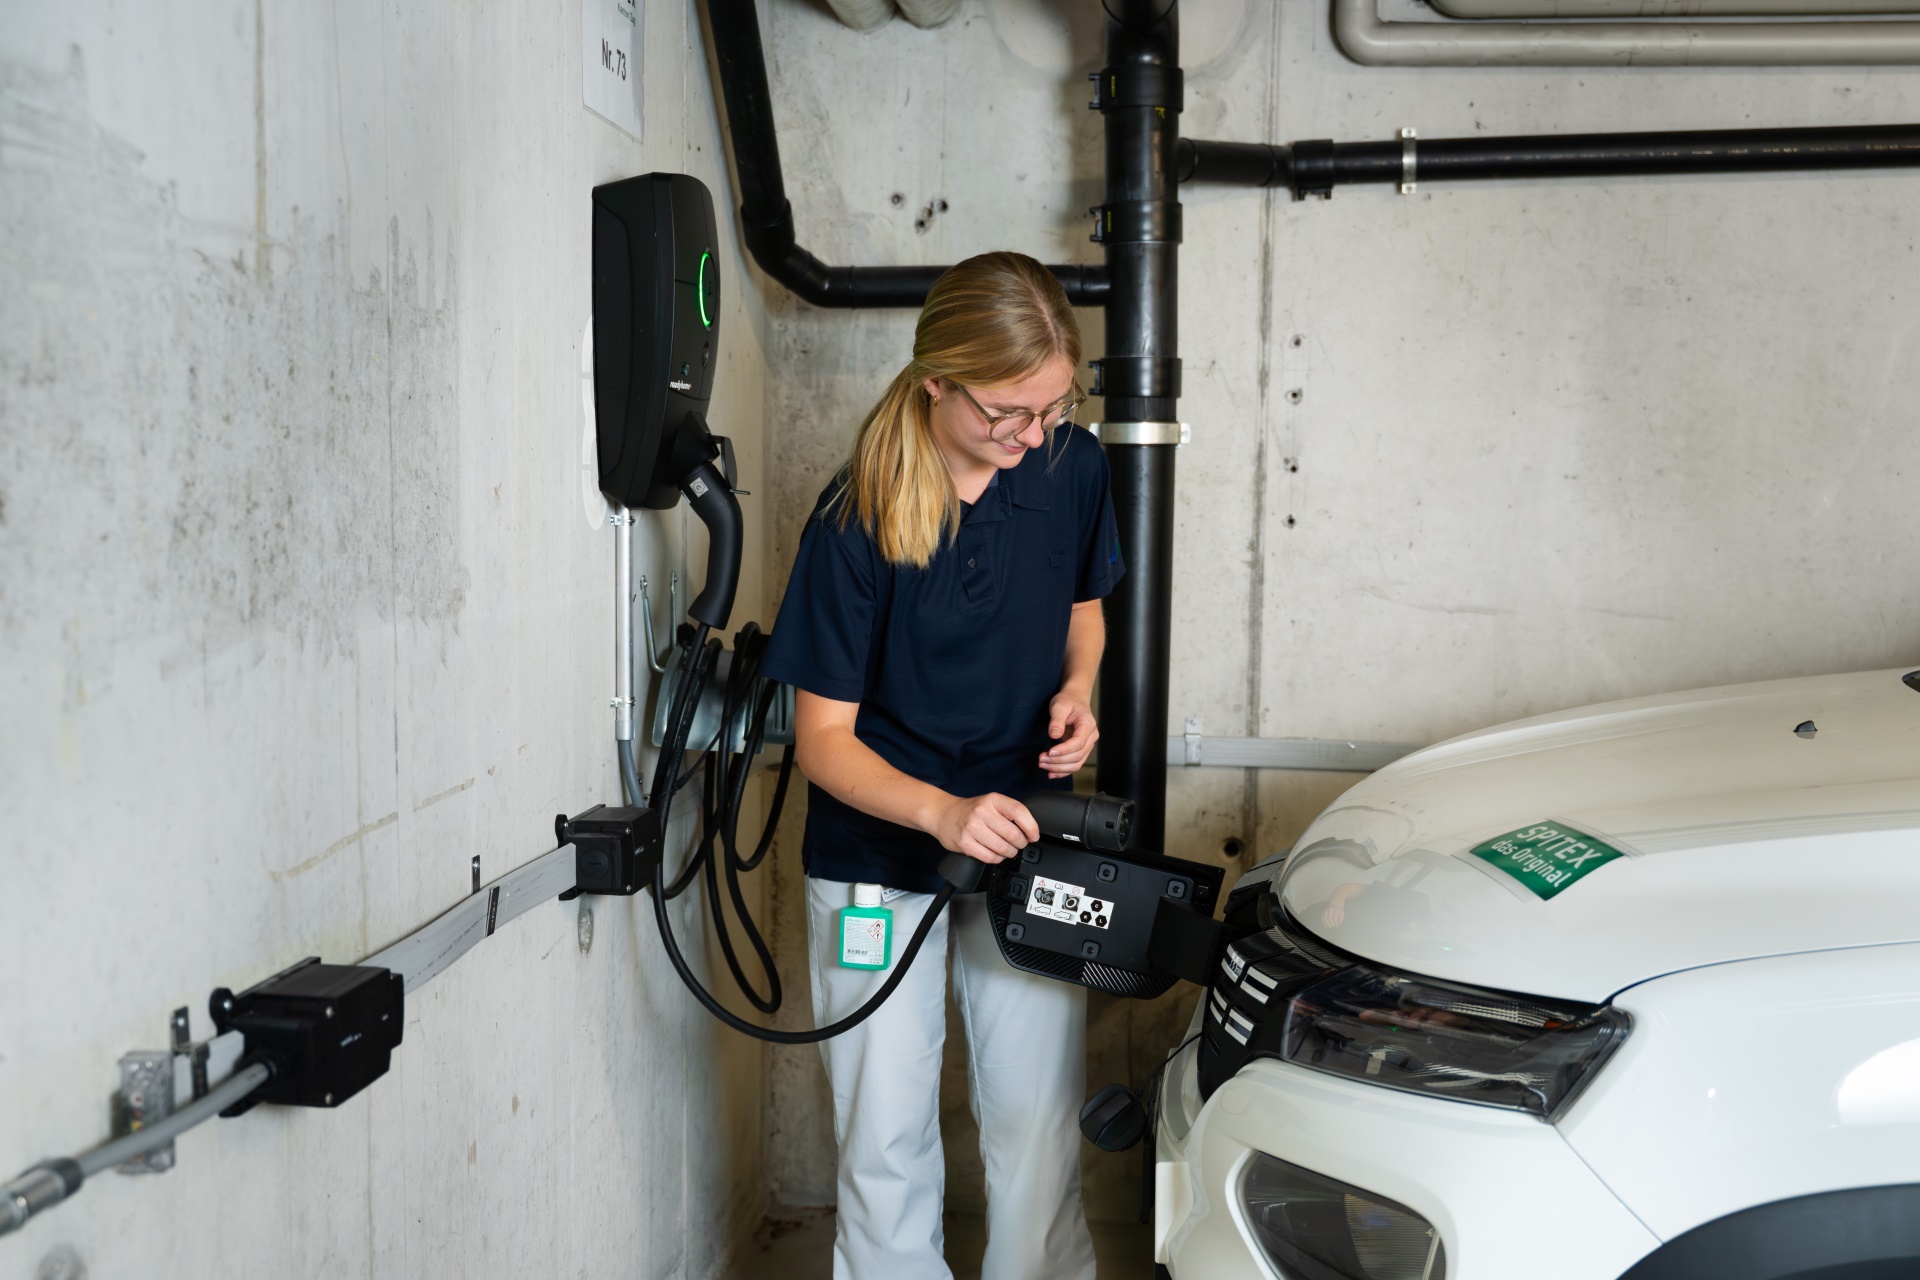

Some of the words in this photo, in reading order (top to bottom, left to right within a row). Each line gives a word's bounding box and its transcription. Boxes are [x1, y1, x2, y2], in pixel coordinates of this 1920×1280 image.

[602, 37, 614, 72] Nr.
[616, 48, 627, 81] 73
[1490, 839, 1519, 855] das
[1511, 847, 1572, 888] Original
[1516, 826, 1603, 870] SPITEX
